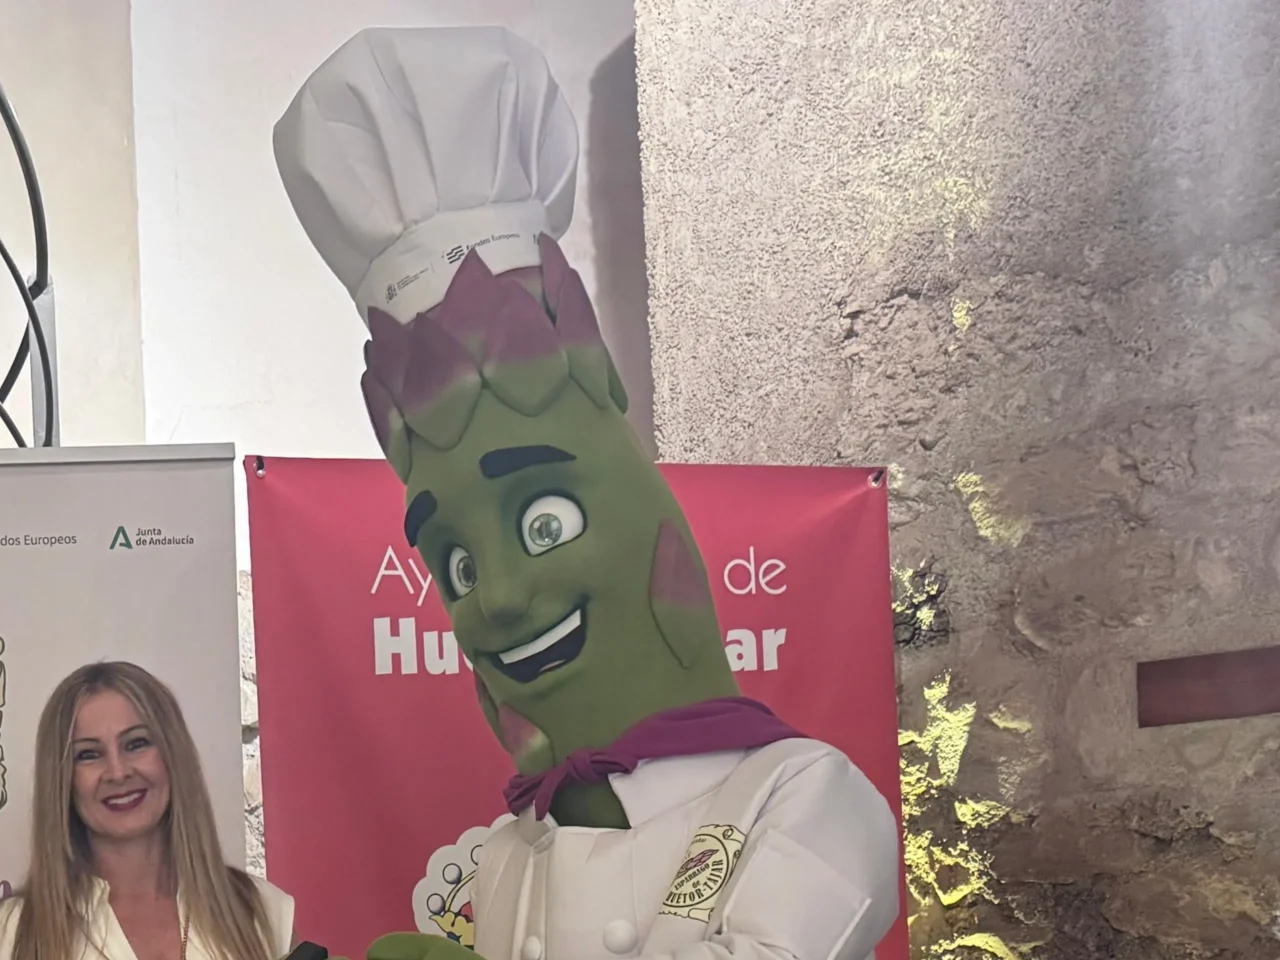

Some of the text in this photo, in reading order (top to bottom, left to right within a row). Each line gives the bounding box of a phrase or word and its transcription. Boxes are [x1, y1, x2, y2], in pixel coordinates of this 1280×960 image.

[135, 527, 162, 537] Junta
[24, 534, 77, 547] Europeos
[135, 535, 194, 546] de Andalucía
[723, 546, 787, 595] de
[691, 880, 702, 889] de
